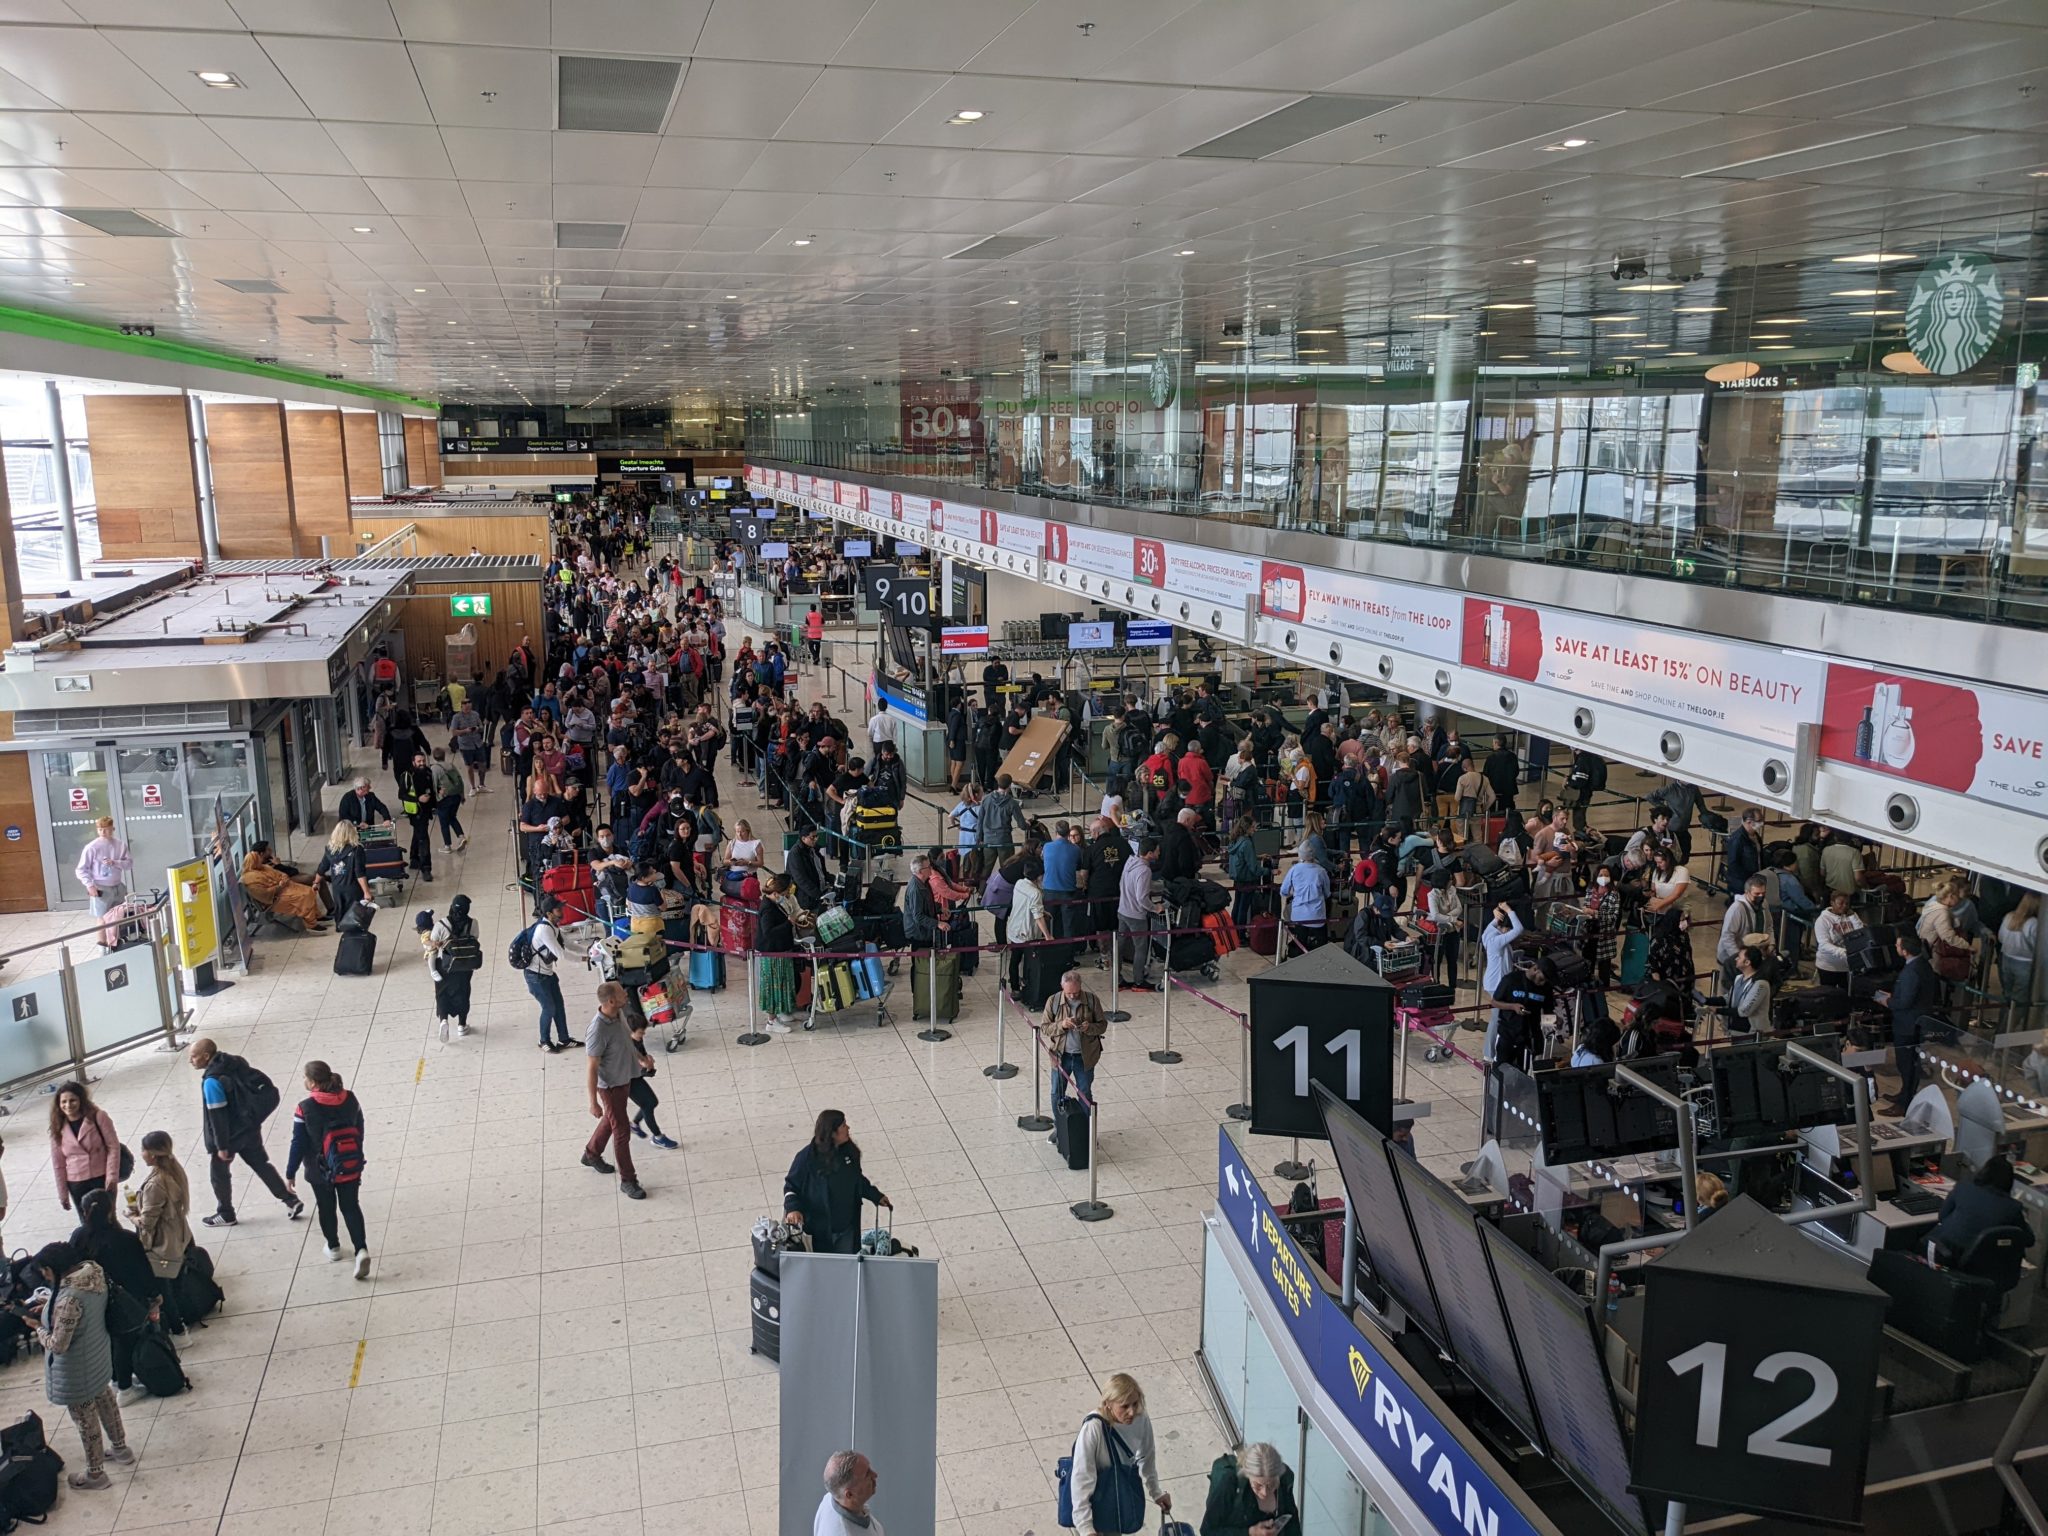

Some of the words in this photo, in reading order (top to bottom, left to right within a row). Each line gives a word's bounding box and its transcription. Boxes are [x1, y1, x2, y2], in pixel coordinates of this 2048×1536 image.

[1390, 345, 1410, 357] FOOD
[1386, 360, 1414, 372] VILLAGE
[1720, 377, 1779, 388] STARBUCKS
[690, 496, 697, 506] 6
[748, 524, 757, 538] 8
[1141, 548, 1158, 574] 30%
[1180, 558, 1189, 568] FREE
[1190, 560, 1206, 572] ALCOHOL
[1207, 563, 1220, 575] PRICES
[1221, 565, 1229, 576] FOR
[1230, 566, 1235, 577] UK
[1236, 568, 1252, 582] FLIGHTS
[876, 578, 890, 600] 9
[896, 592, 926, 616] 10
[1309, 590, 1320, 601] FLY
[1322, 593, 1340, 606] AWAY
[1342, 596, 1360, 610] WITH
[1363, 602, 1390, 617] TREATS
[1391, 606, 1406, 623] from
[1408, 612, 1424, 624] THE
[1427, 615, 1451, 630] LOOP
[1546, 670, 1556, 678] THE
[1555, 636, 1588, 658] SAVE
[1592, 644, 1609, 662] AT
[1614, 648, 1658, 672] LEAST
[1696, 666, 1722, 688] ON
[1729, 672, 1802, 704] BEAUTY
[1591, 680, 1605, 690] SAVE
[1606, 683, 1619, 693] TIME
[1621, 687, 1633, 697] AND
[1635, 690, 1652, 701] SHOP
[1653, 695, 1676, 708] ONLINE
[1678, 702, 1686, 710] AT
[1687, 704, 1725, 720] THELOOP.IE
[1993, 734, 2043, 759] SAVE
[1989, 780, 2009, 790] THE
[2012, 786, 2043, 796] LOOP
[1272, 1025, 1360, 1100] 11
[1262, 1210, 1311, 1308] DEPARTURE
[1272, 1257, 1299, 1317] GATES
[1667, 1341, 1838, 1467] 12
[1374, 1376, 1498, 1536] RYAN
